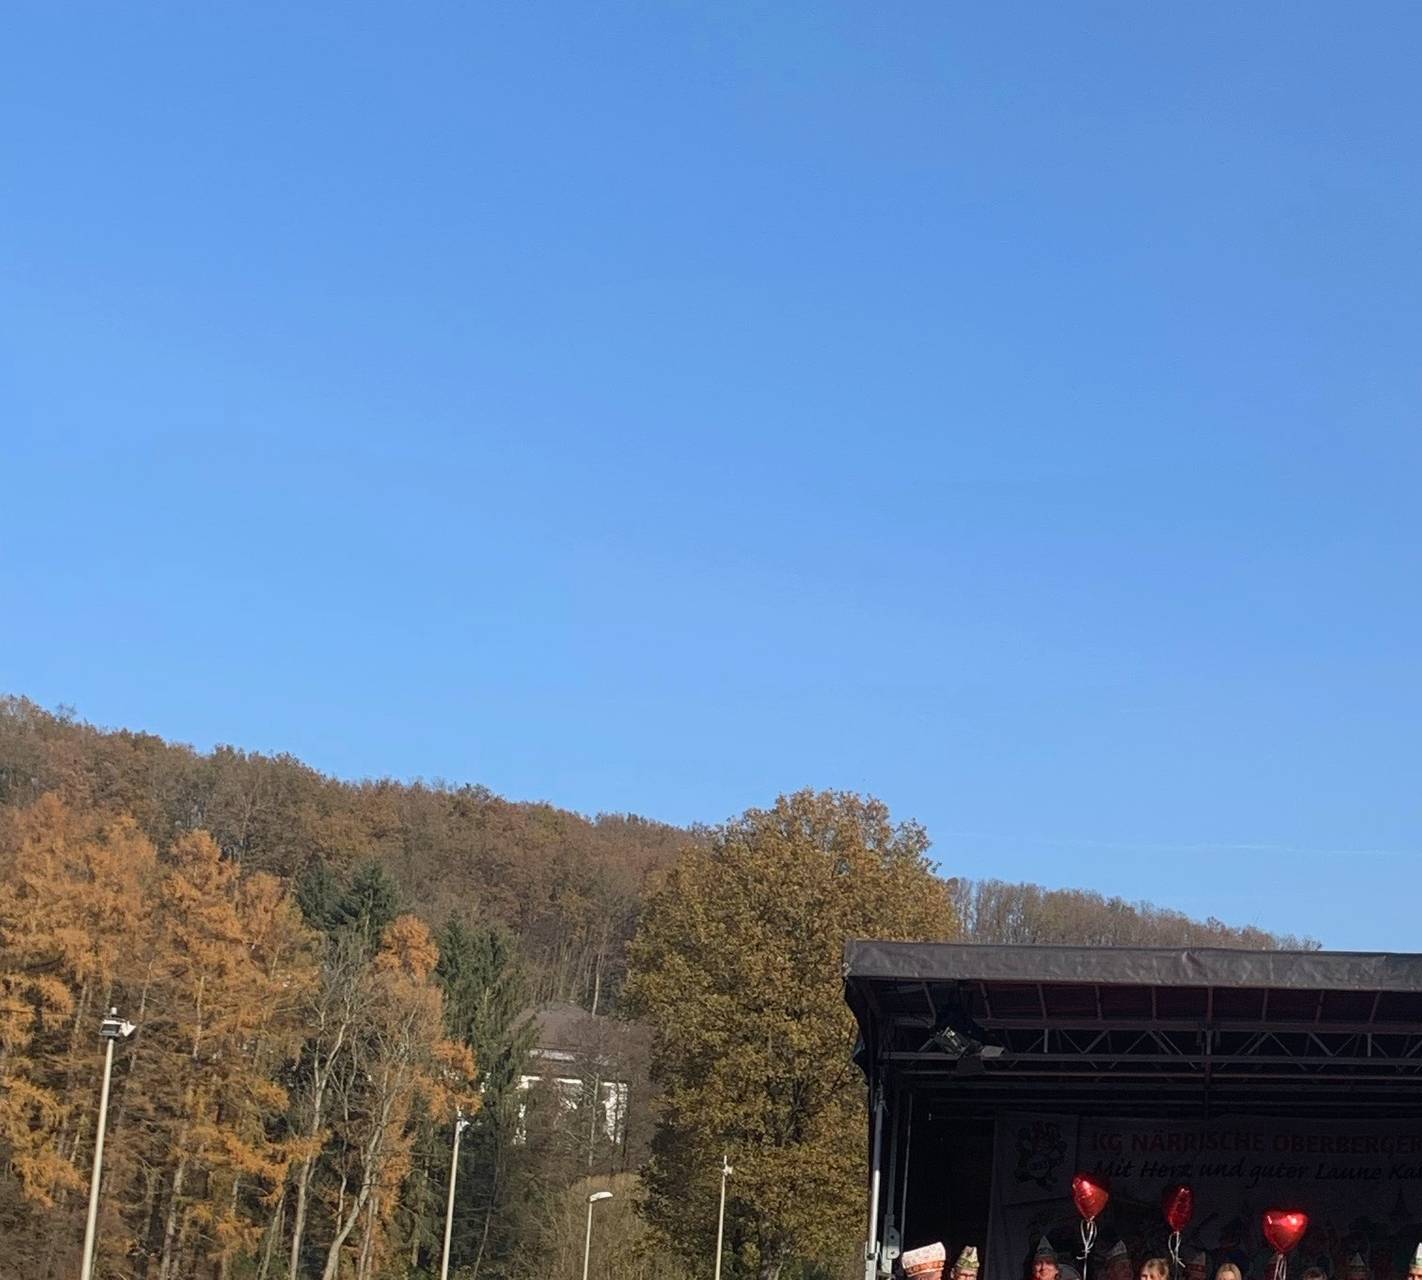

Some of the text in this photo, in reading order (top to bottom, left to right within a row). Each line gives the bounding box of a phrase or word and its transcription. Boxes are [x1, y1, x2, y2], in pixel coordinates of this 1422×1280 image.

[1091, 1131, 1122, 1153] KG
[1132, 1129, 1263, 1153] NÄRRISCHE
[1093, 1159, 1133, 1178] Mit
[1140, 1160, 1194, 1178] Herz
[1199, 1157, 1245, 1178] und
[1247, 1161, 1308, 1188] guter
[1314, 1163, 1382, 1181] Laune
